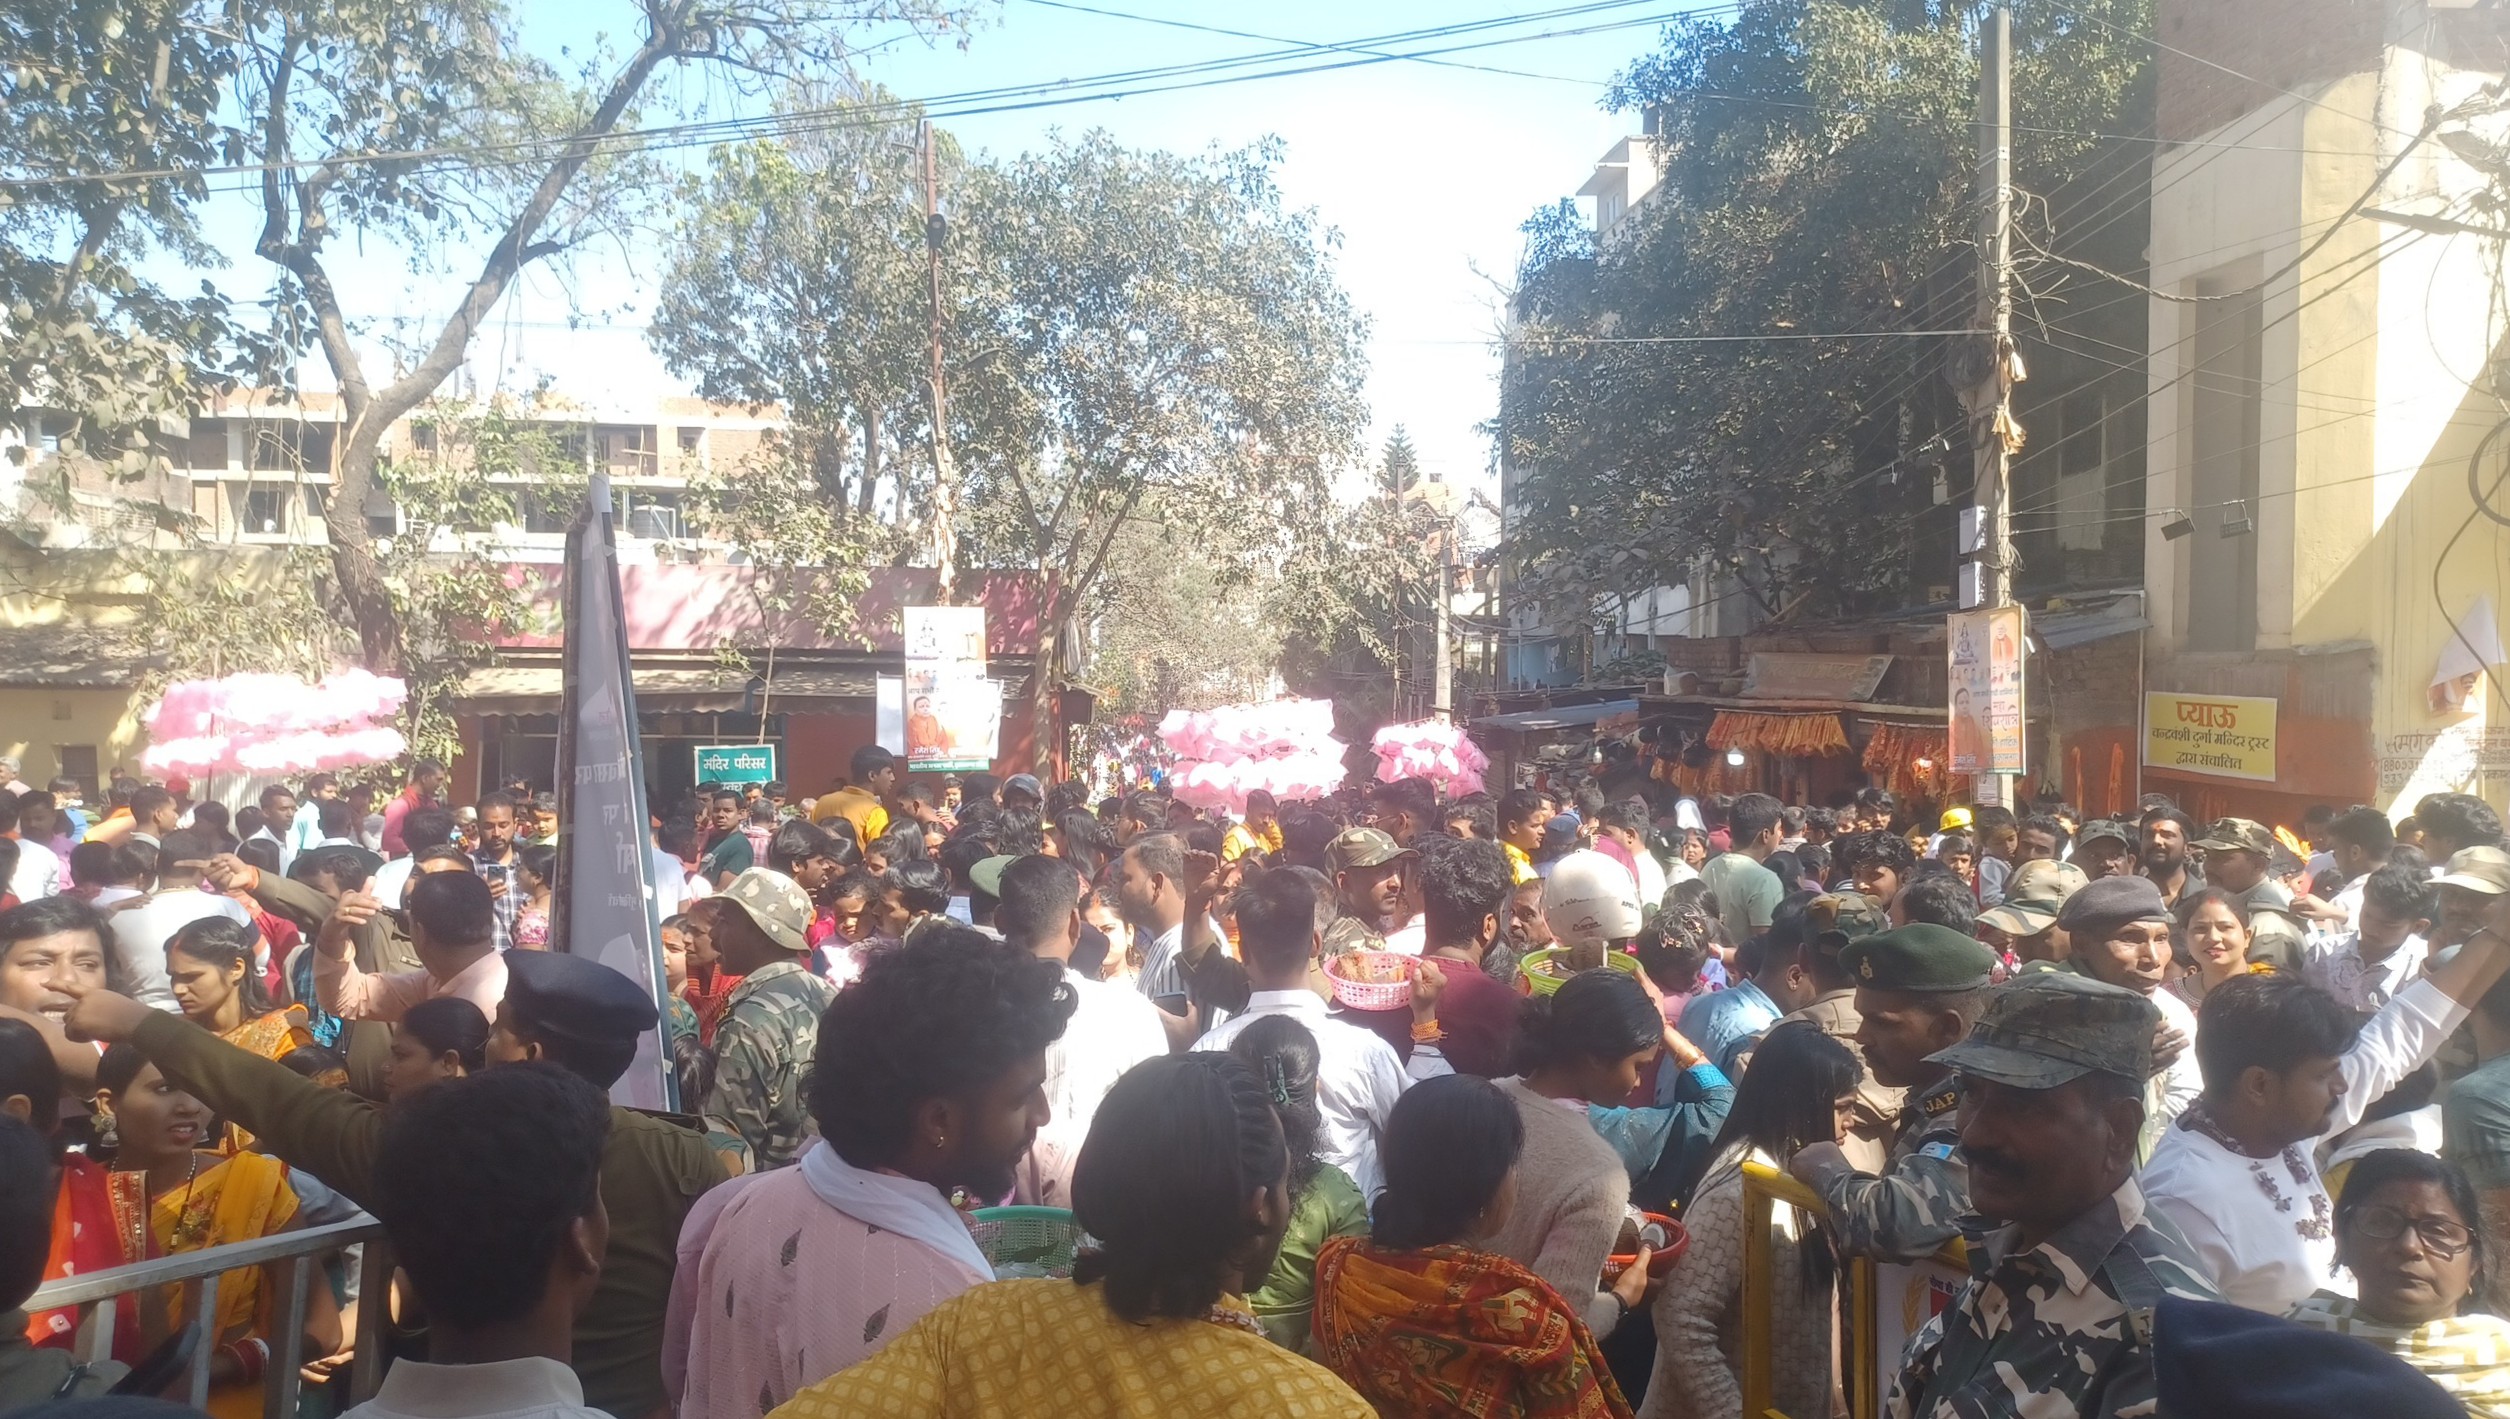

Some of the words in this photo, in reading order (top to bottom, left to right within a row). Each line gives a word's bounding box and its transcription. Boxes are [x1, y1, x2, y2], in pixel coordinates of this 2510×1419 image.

[2176, 701, 2238, 729] प्याऊ
[2192, 730, 2211, 748] दुर्गा
[2214, 730, 2246, 747] मन्दिर
[2247, 736, 2270, 752] ट्रस्ट
[734, 752, 766, 769] परिसर
[2176, 751, 2197, 766] द्वारा
[2200, 751, 2242, 770] संचालित
[1925, 1092, 1955, 1113] JAP
